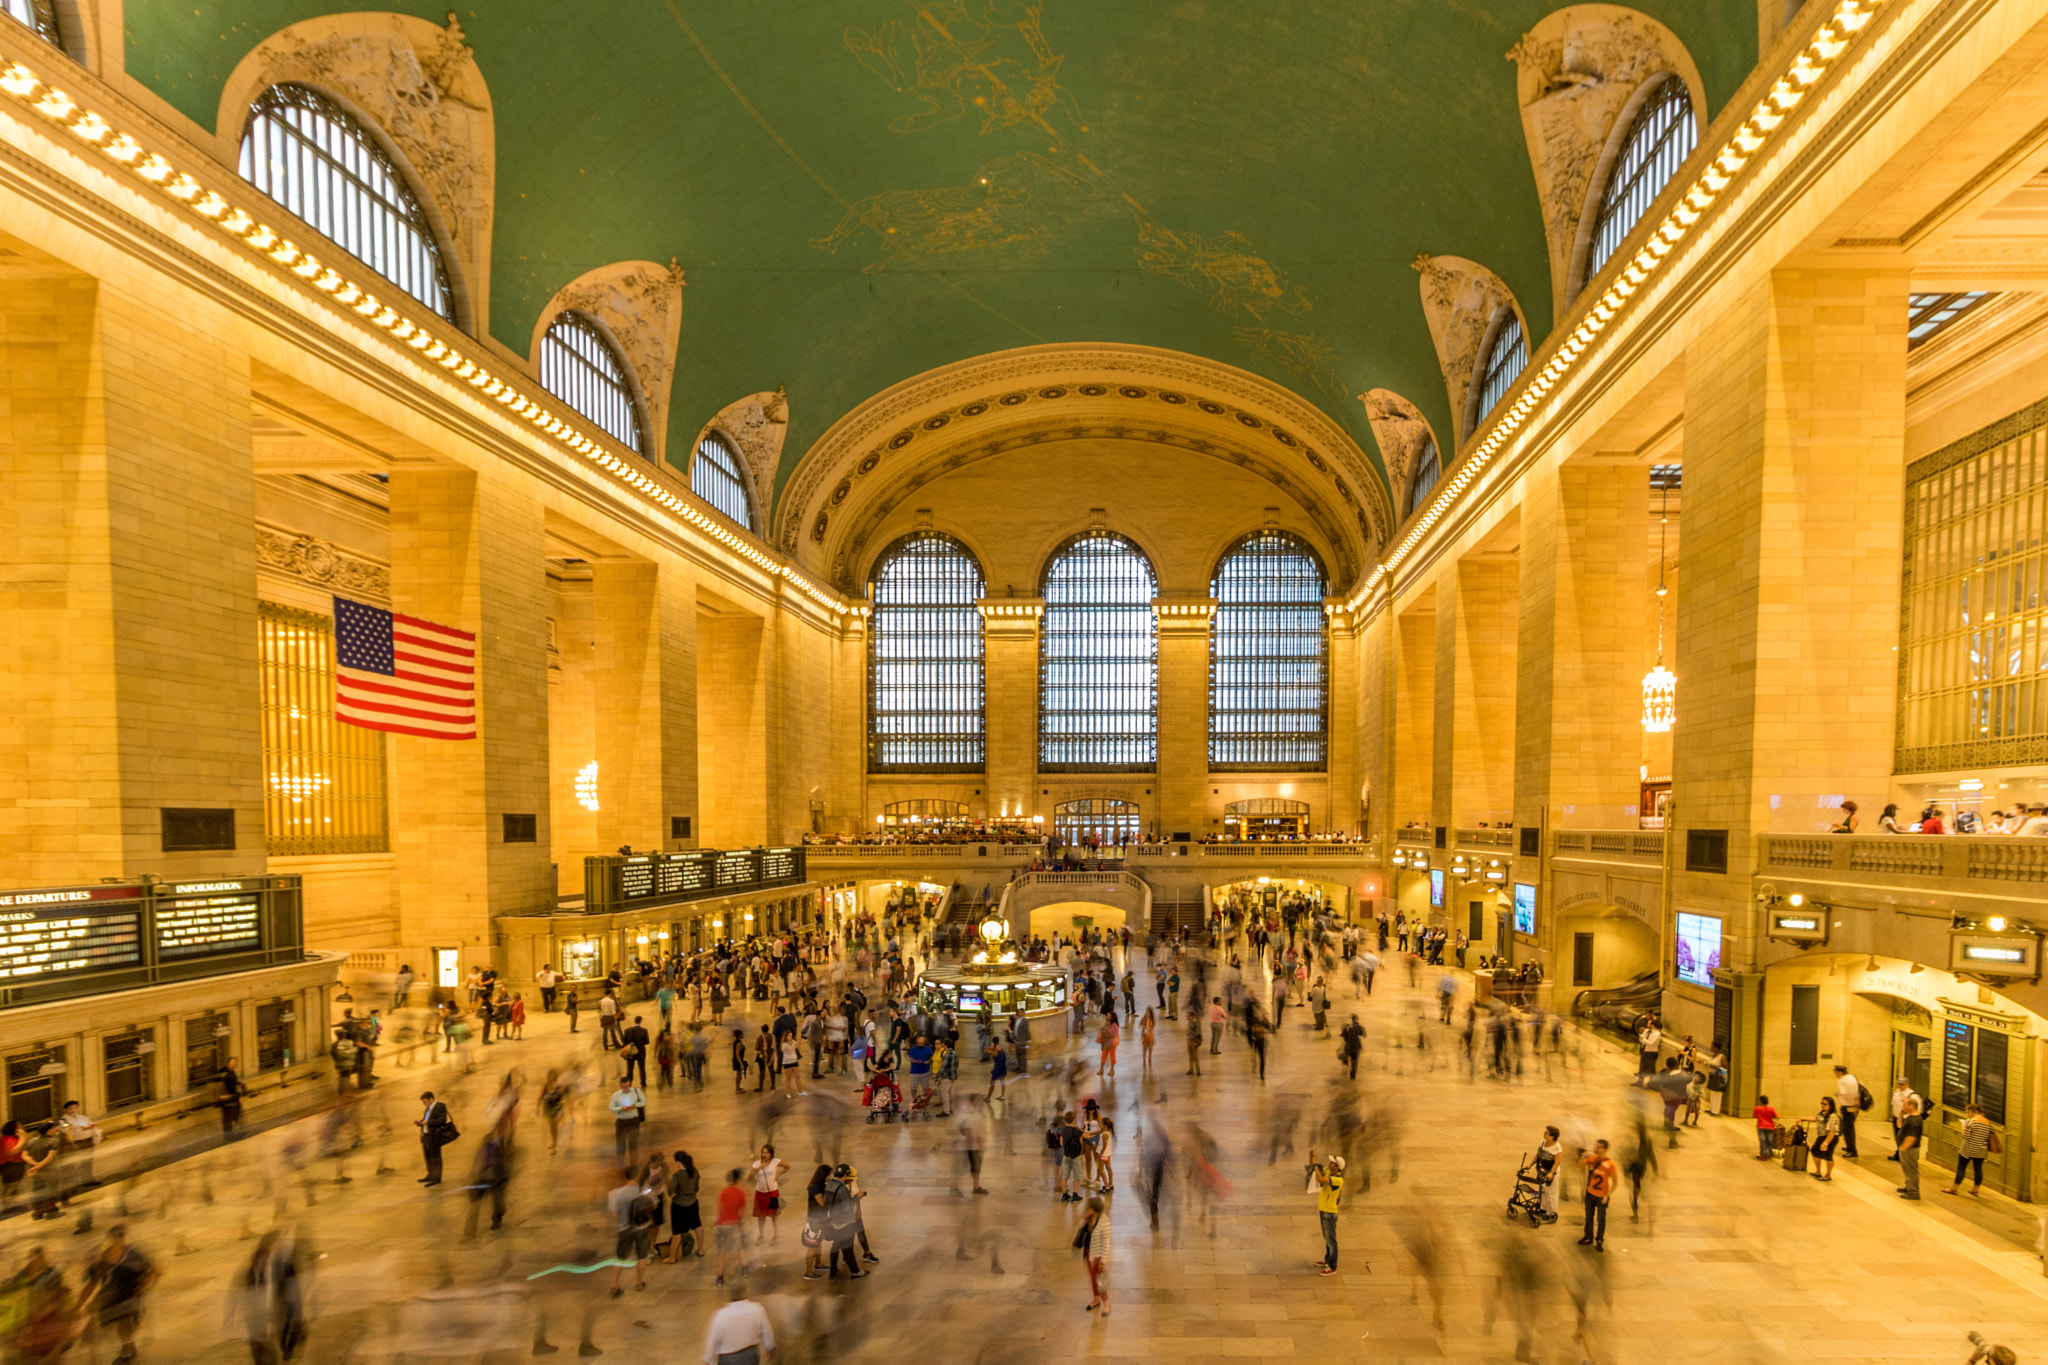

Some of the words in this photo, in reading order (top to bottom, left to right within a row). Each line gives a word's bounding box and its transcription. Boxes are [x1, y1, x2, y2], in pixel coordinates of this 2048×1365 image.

[175, 881, 243, 894] INFORMATION
[15, 891, 91, 905] DEPARTURES
[1626, 899, 1647, 918] STREET
[1876, 976, 1908, 992] TRACKS
[1949, 1009, 1964, 1018] TRACK
[1981, 1017, 1999, 1027] TRACK
